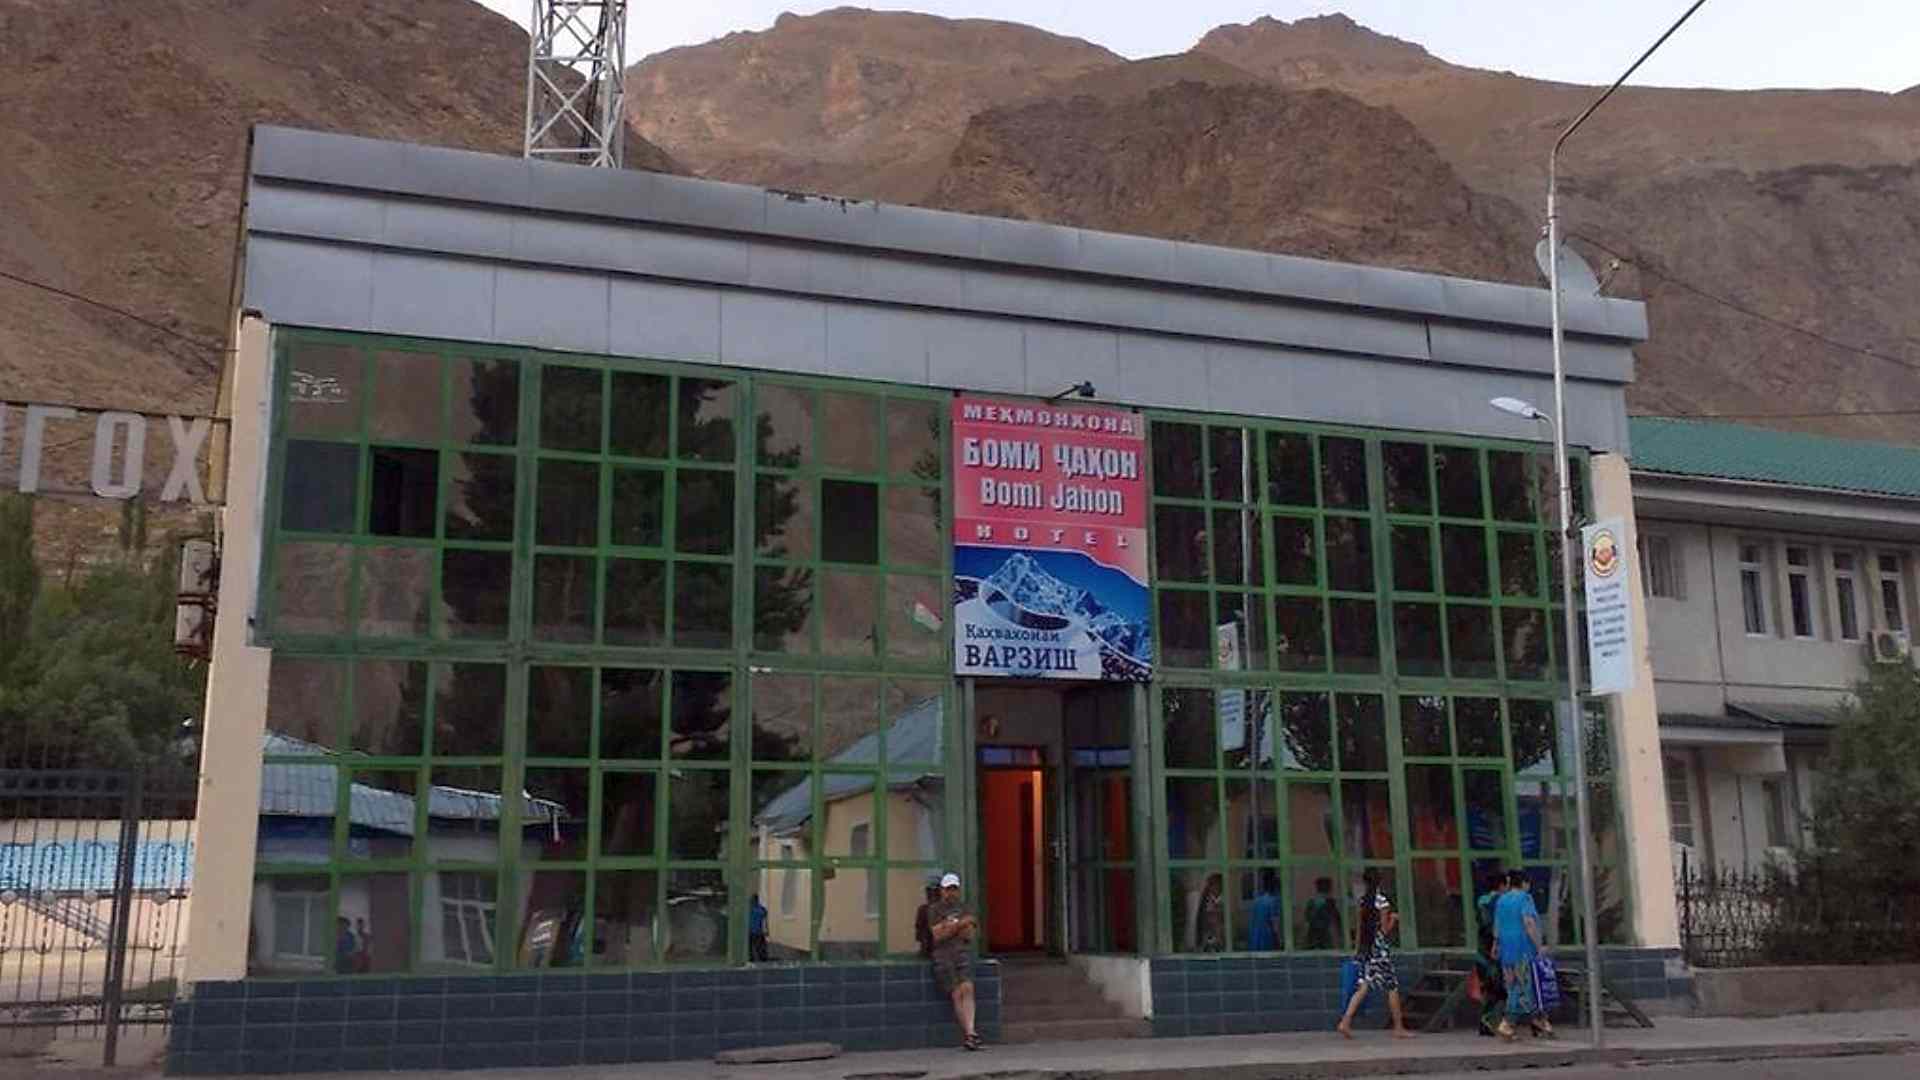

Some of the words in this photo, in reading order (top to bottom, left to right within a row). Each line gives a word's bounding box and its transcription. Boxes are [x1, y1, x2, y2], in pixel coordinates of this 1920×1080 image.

[0, 404, 211, 502] ГОХ
[963, 437, 1042, 472] БОМИ
[981, 477, 1043, 509] Bomi
[1051, 482, 1124, 516] Jahon
[976, 524, 1130, 547] HOTEL
[964, 644, 1078, 671] ВАРЗИШ
